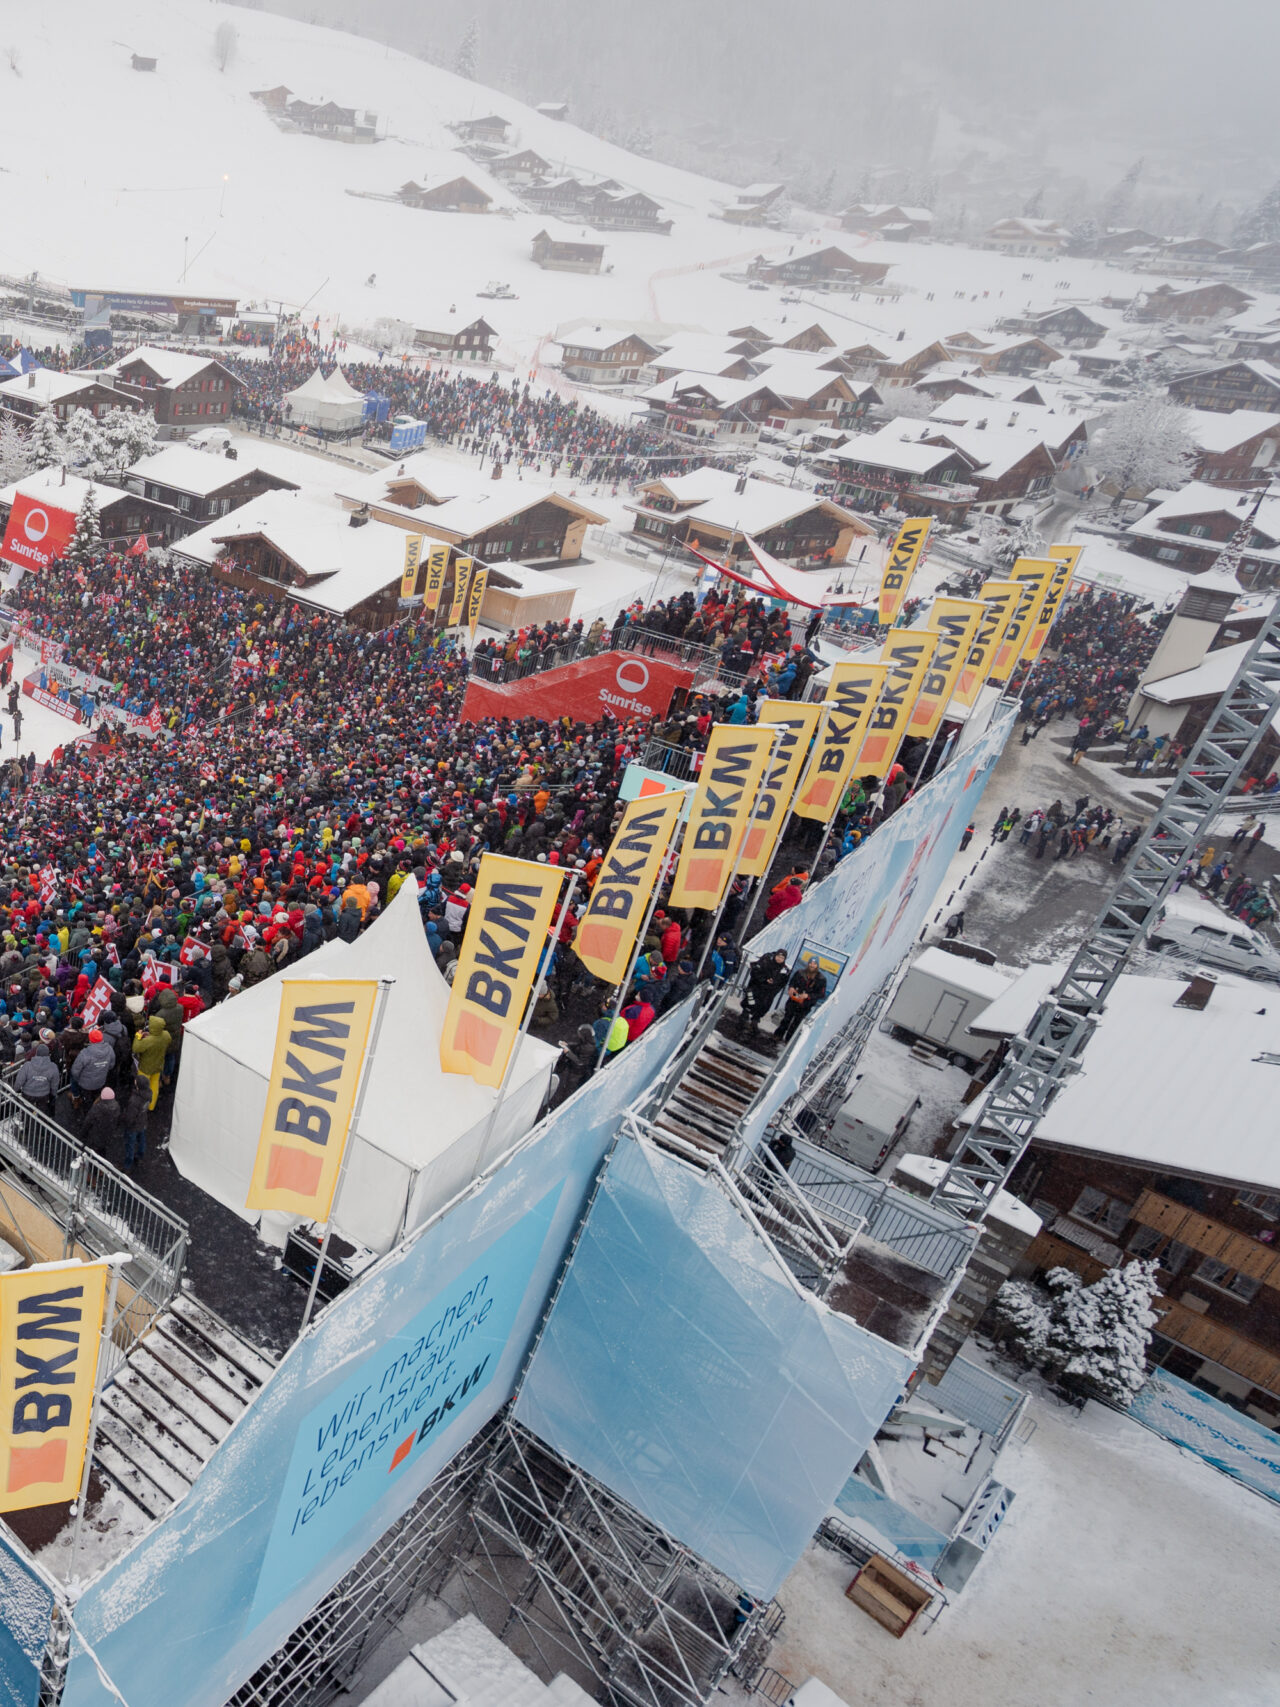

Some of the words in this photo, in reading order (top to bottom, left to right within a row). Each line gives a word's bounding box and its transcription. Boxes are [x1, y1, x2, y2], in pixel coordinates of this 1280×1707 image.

[9, 538, 50, 565] Sunrise
[406, 540, 419, 578] BKW
[429, 551, 445, 590] BKW
[456, 565, 469, 605] BKW
[884, 528, 922, 590] BKW
[598, 688, 653, 717] Sunrise
[872, 645, 925, 730] BKW
[927, 615, 972, 696] BKW
[752, 719, 805, 820] BKW
[820, 678, 873, 774] BKW
[694, 743, 758, 851] BKW
[590, 806, 667, 920] BKW
[465, 882, 544, 1018] BKW
[274, 1001, 356, 1146] BKW
[11, 1285, 84, 1435] BKW
[302, 1298, 493, 1497] Lebensräume
[317, 1384, 372, 1452] Wir
[379, 1275, 489, 1393] machen
[416, 1352, 491, 1445] BKW
[291, 1359, 456, 1536] lebenswert.
